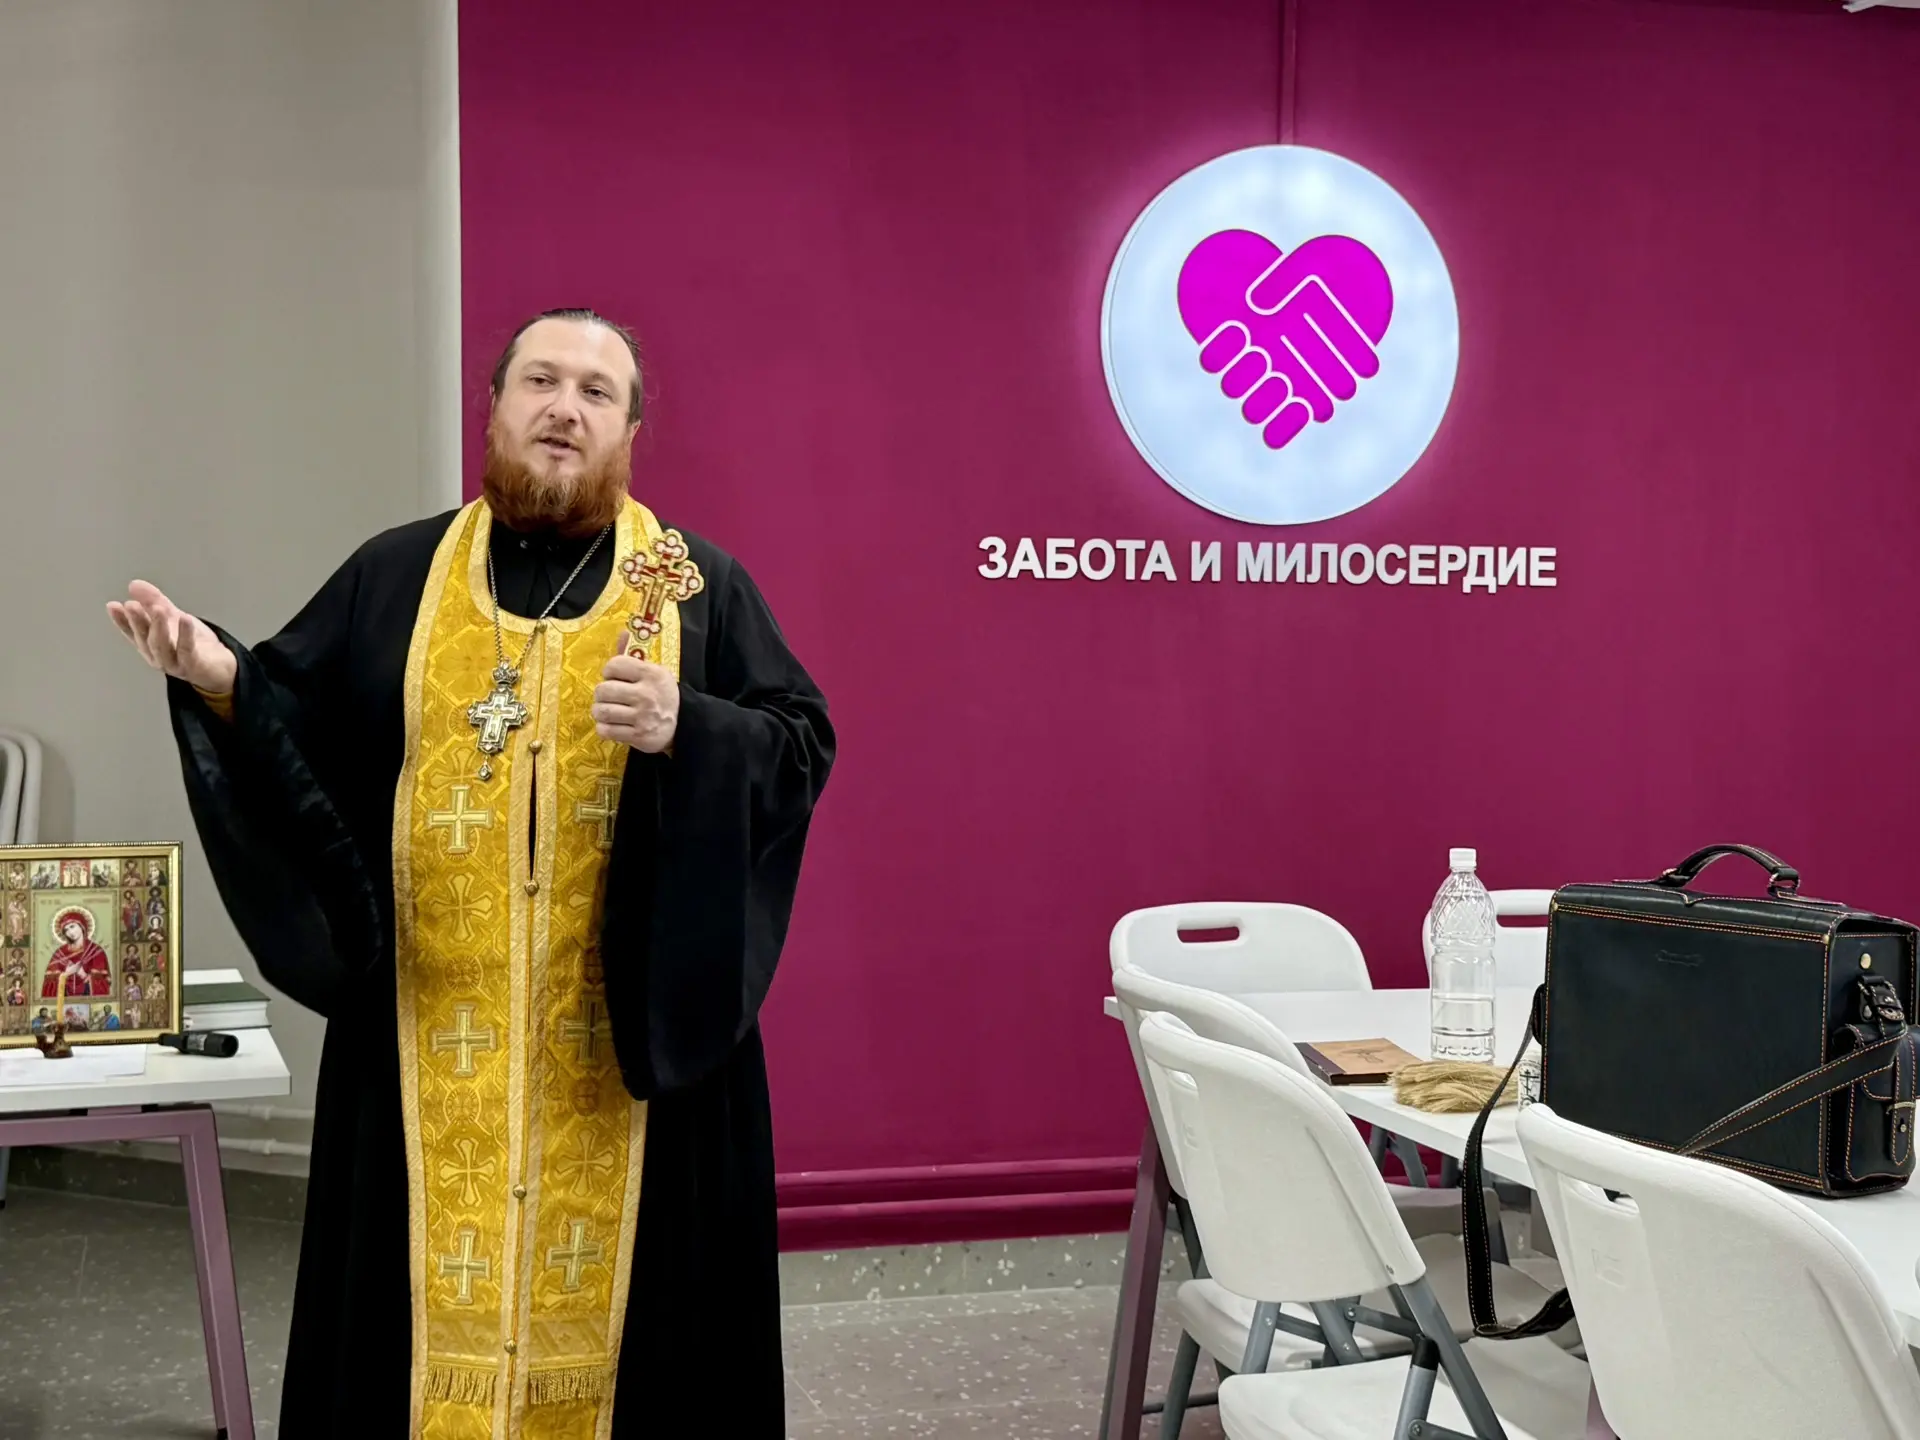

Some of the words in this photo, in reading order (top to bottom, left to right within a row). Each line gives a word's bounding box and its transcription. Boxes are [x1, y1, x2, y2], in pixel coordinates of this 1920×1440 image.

[977, 536, 1177, 581] ЗАБОТА
[1191, 541, 1222, 581] И
[1236, 541, 1557, 593] МИЛОСЕРДИЕ
